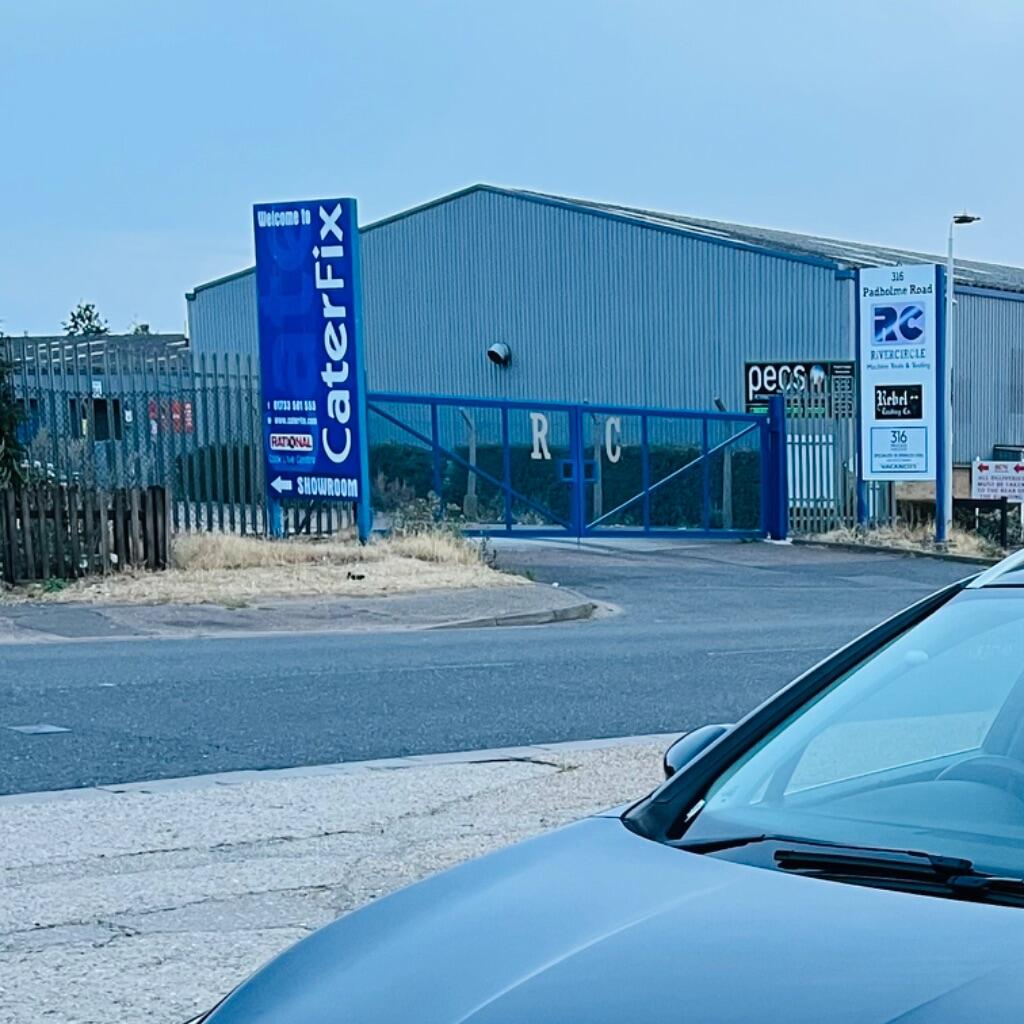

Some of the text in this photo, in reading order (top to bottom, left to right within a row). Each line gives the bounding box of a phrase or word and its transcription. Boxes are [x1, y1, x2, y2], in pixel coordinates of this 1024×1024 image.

[257, 208, 311, 227] Welcome to
[890, 271, 905, 281] 316
[863, 284, 933, 297] Padholme Road
[312, 203, 351, 463] CaterFix
[748, 365, 806, 401] pecs
[271, 435, 312, 449] RATIONAL
[530, 412, 621, 463] R C
[890, 430, 907, 443] 316
[296, 476, 359, 498] SHOWROOM
